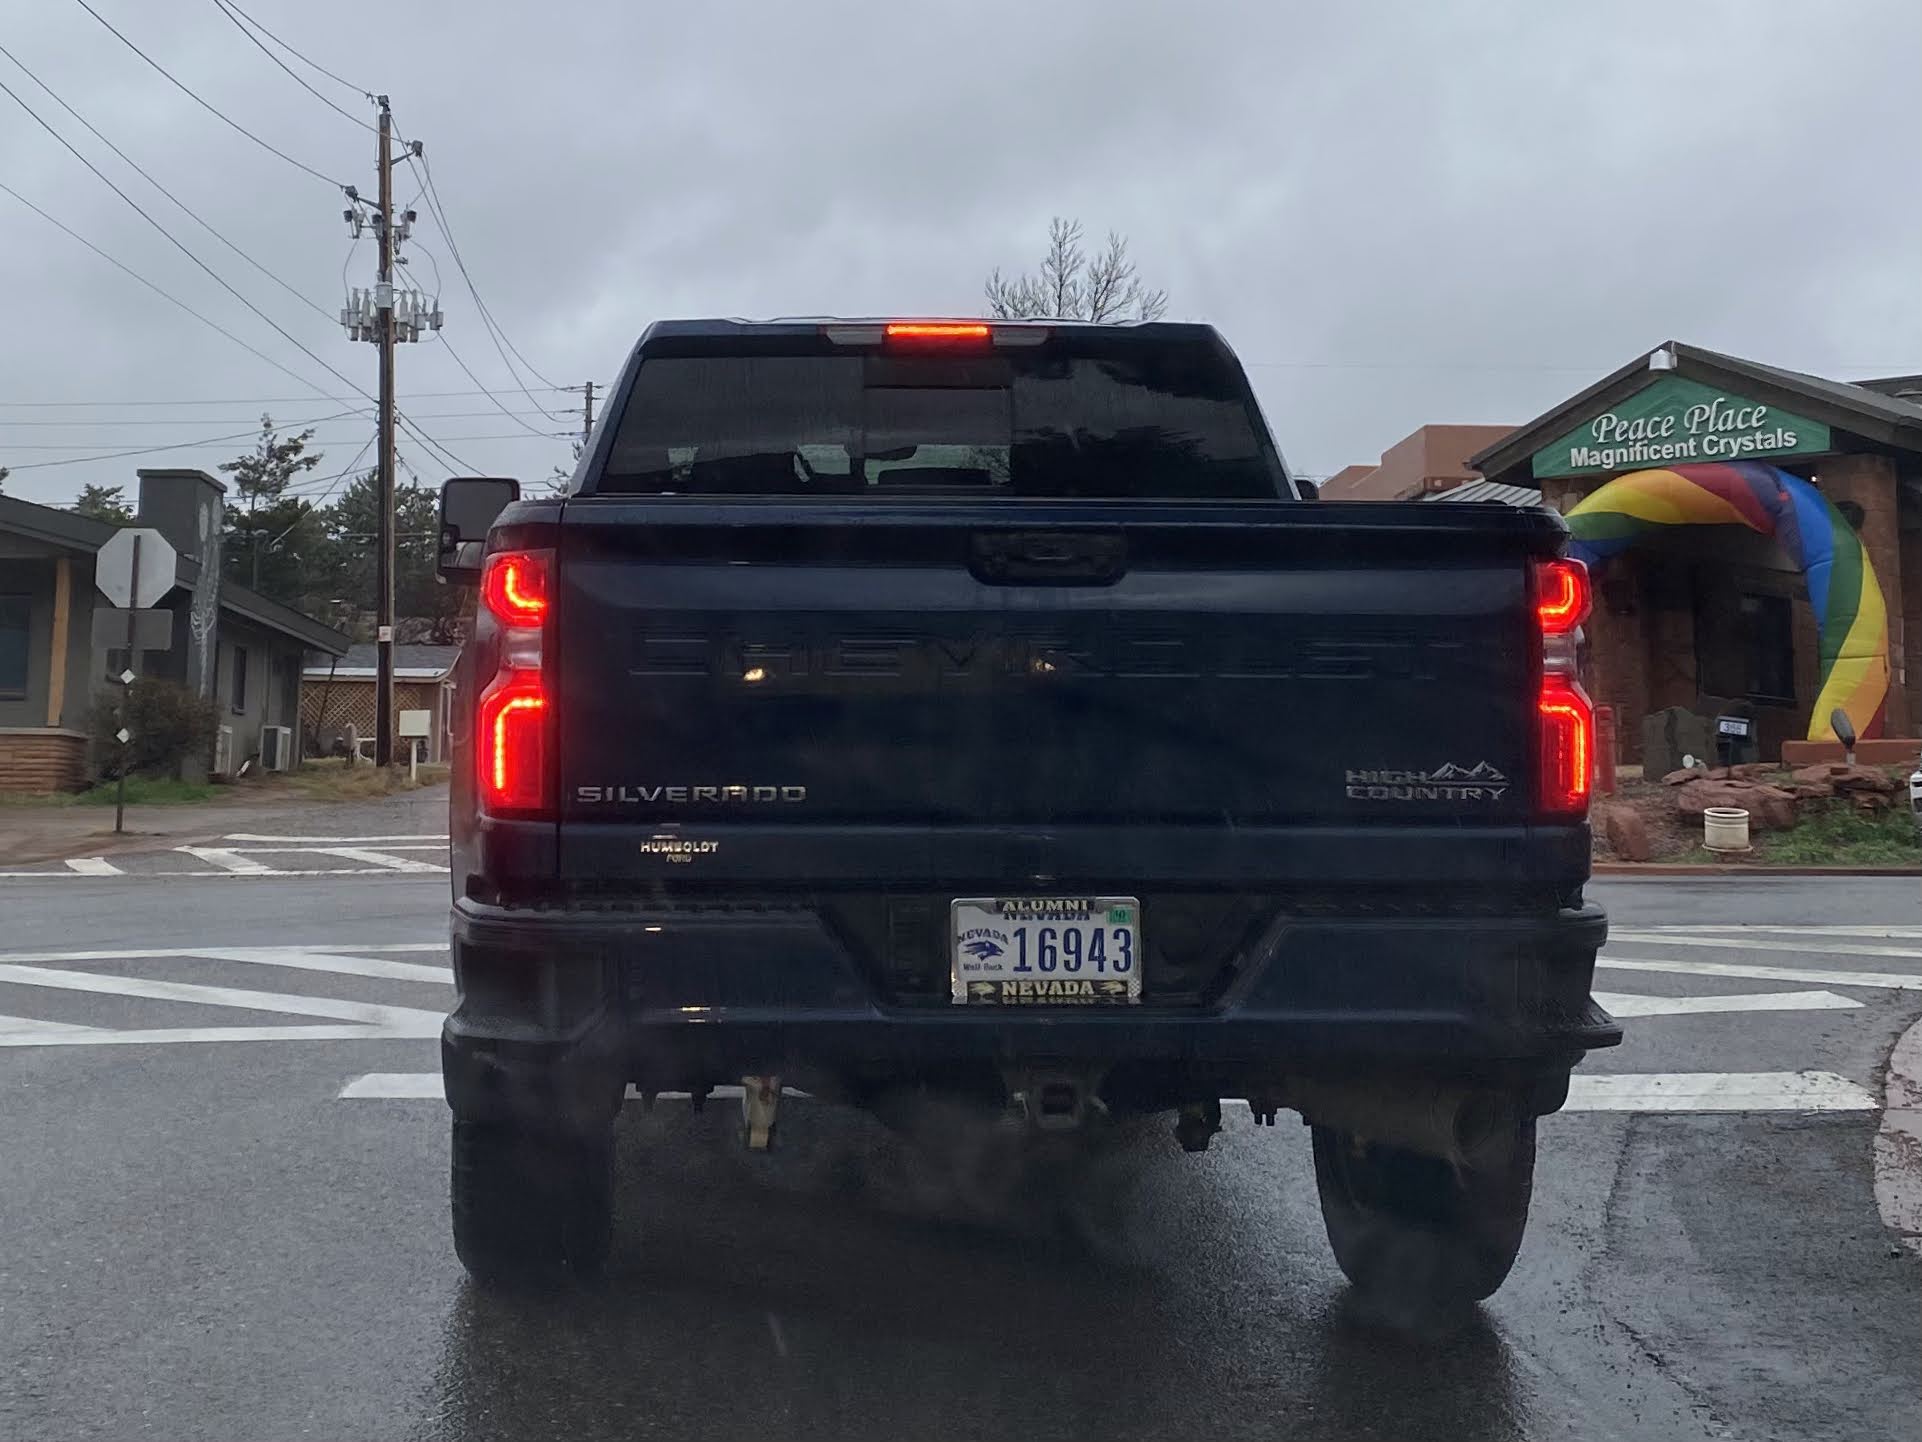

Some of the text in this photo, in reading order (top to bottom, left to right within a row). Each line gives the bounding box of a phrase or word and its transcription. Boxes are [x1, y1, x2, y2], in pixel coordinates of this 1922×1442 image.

[1592, 397, 1767, 444] Peace Place
[1570, 428, 1797, 469] Magnificent Crystals
[1345, 769, 1427, 784] HIGH
[577, 785, 807, 803] SILVERADO
[1346, 786, 1506, 801] COUNTRY
[640, 841, 718, 853] HUMBOLDT
[1003, 899, 1088, 912] ALUMNI
[957, 928, 1009, 945] NEVADA
[1013, 927, 1132, 973] 16943
[1002, 980, 1095, 996] NEVADA
